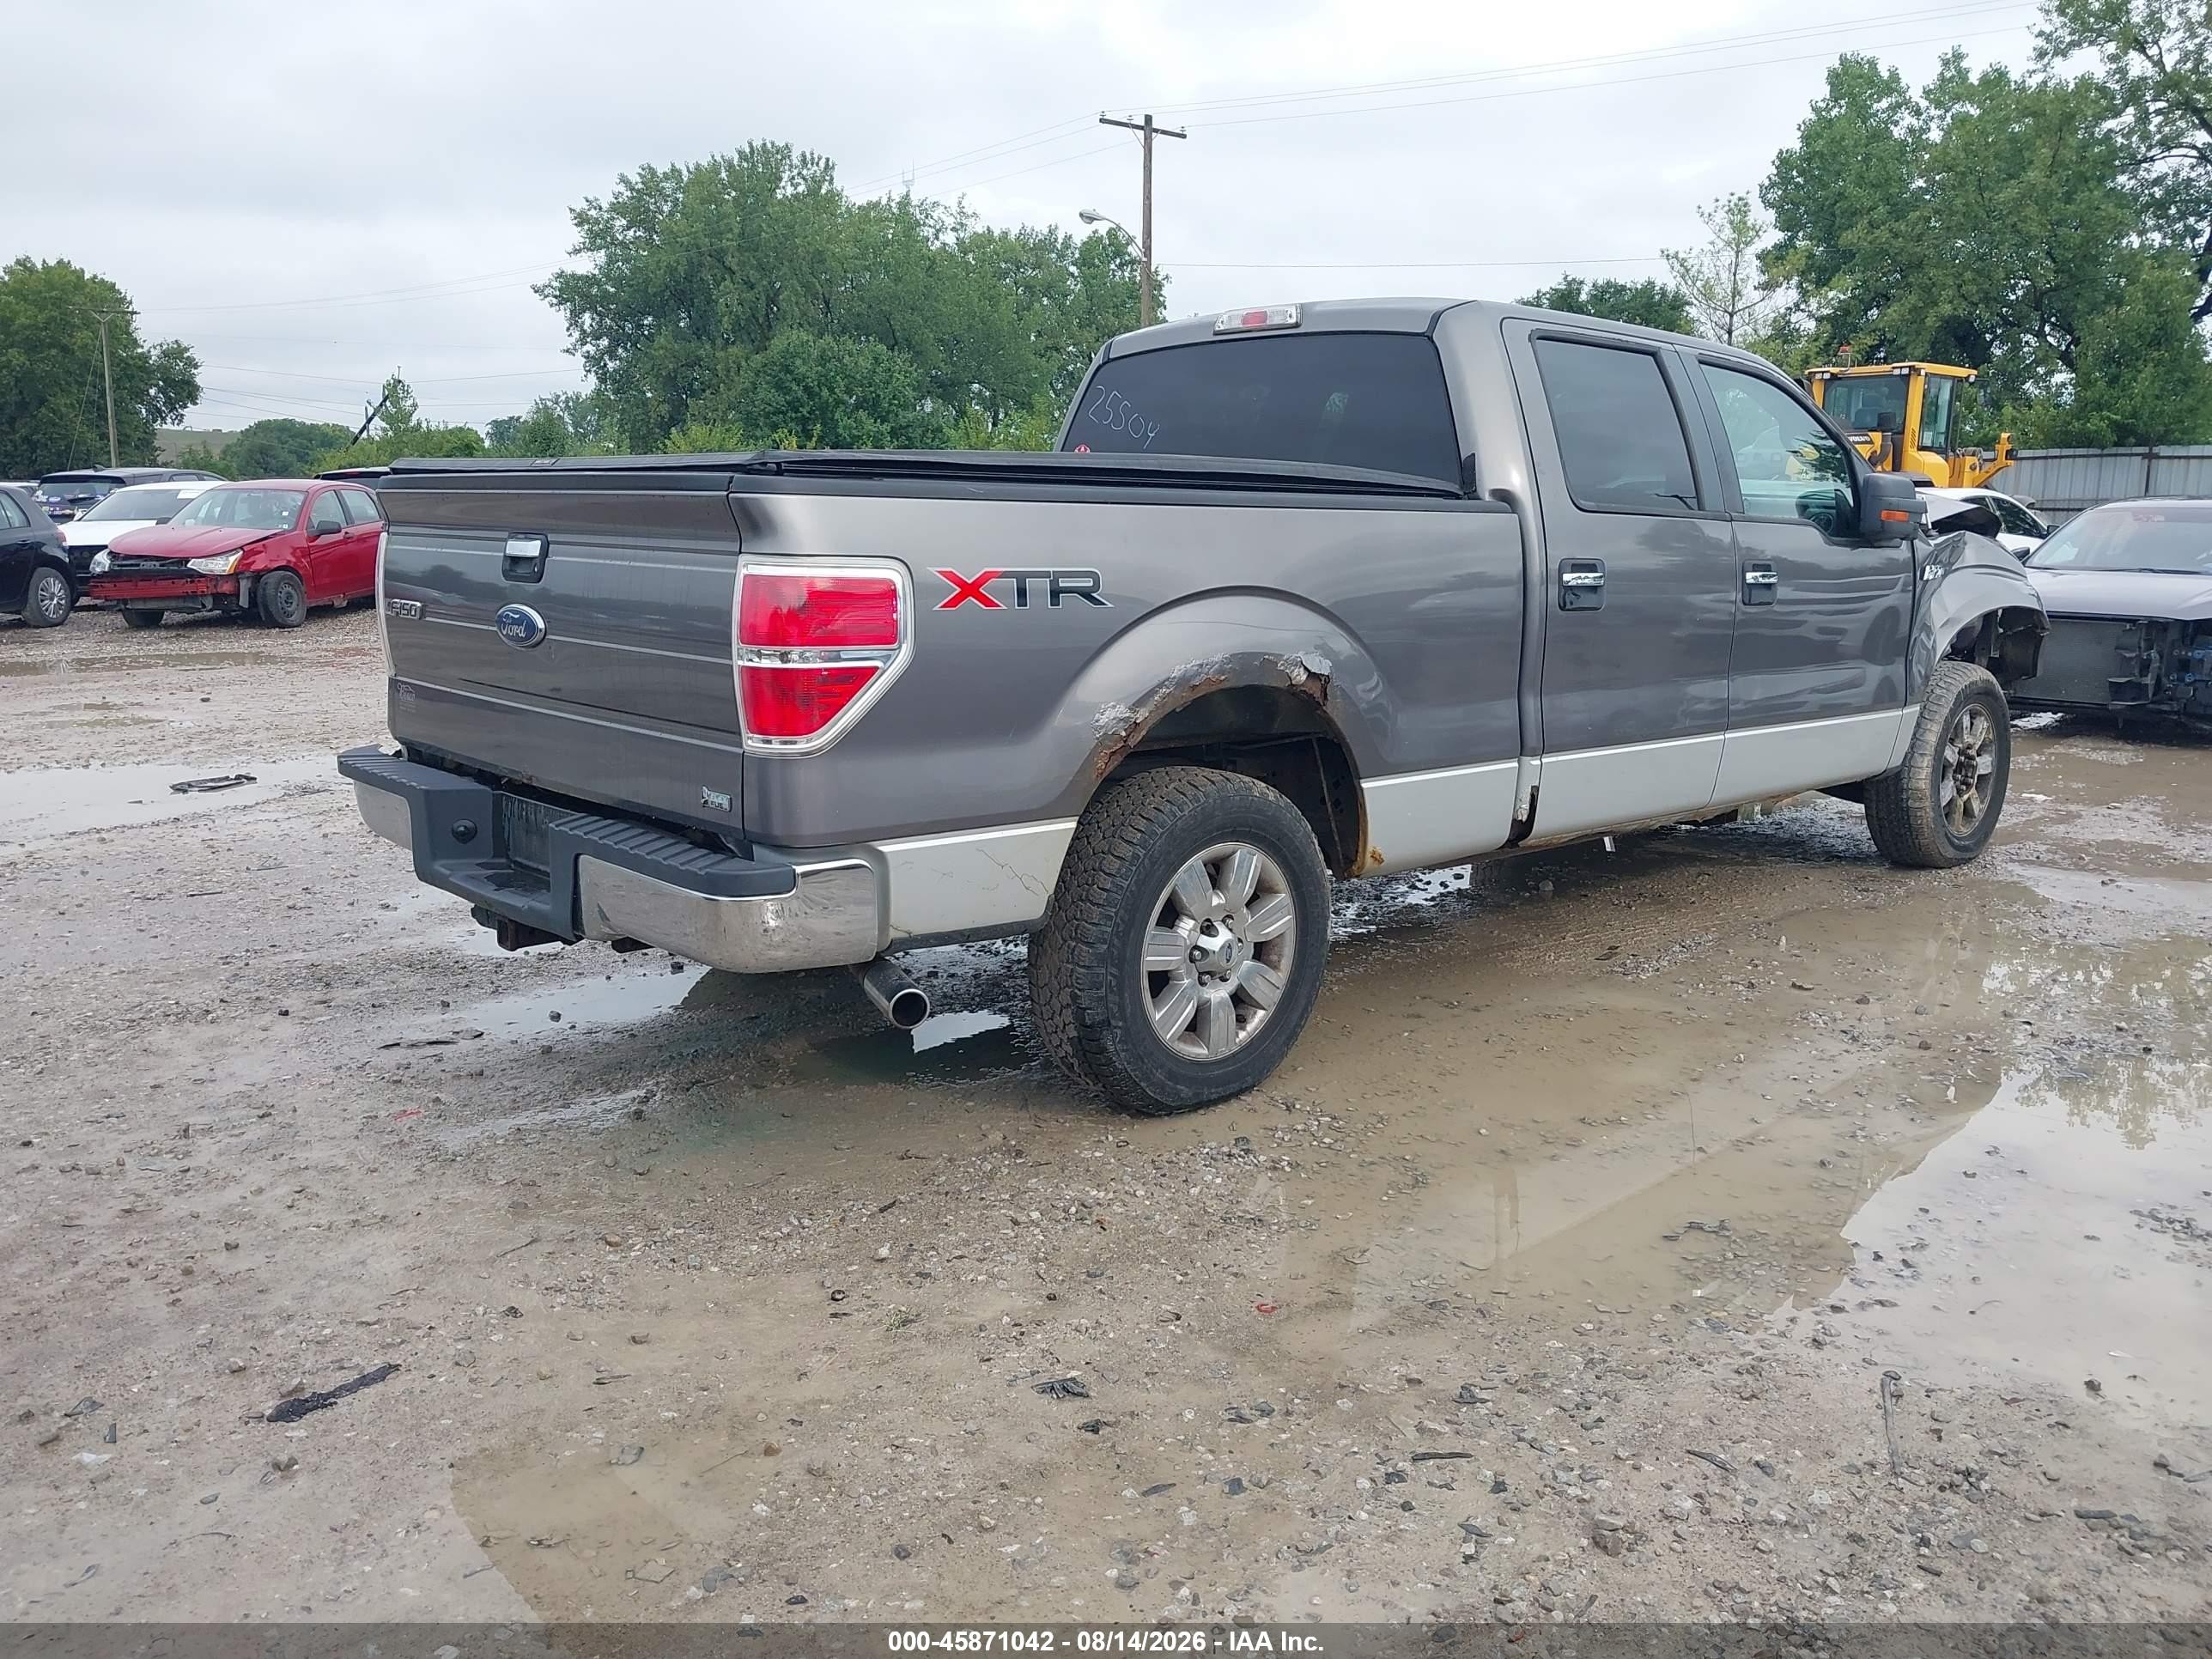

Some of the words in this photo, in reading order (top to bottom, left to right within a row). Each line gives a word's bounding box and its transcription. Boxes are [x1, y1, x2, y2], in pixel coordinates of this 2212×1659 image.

[1088, 386, 1160, 450] 25504
[927, 567, 1115, 610] XTR
[501, 611, 528, 638] Ford
